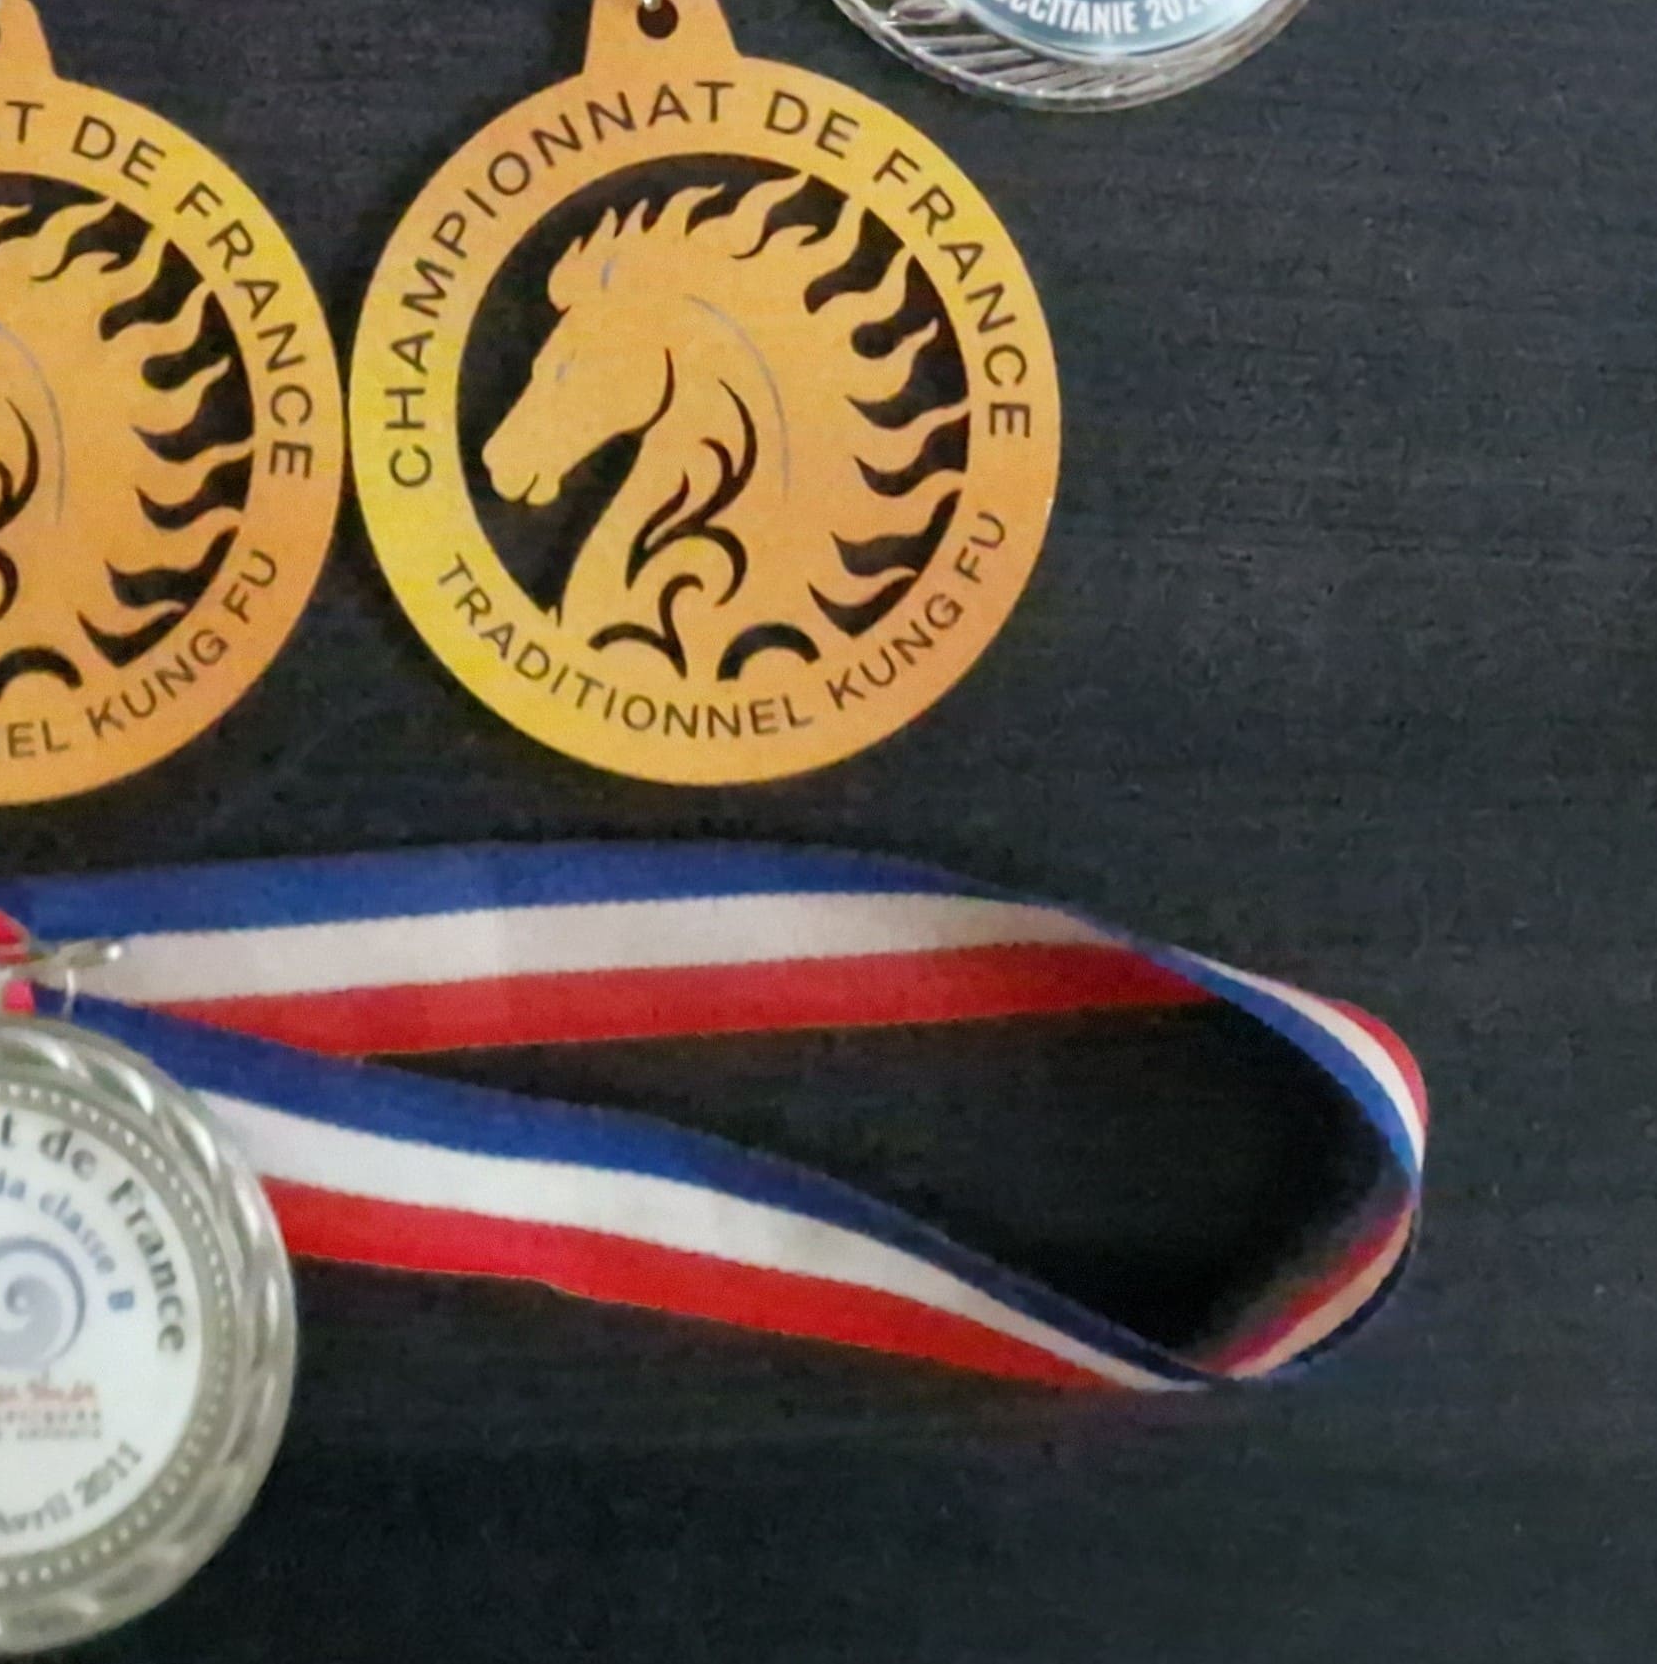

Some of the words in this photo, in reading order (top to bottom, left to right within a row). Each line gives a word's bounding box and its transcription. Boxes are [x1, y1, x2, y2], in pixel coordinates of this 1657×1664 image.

[70, 113, 166, 190] DE
[173, 181, 315, 481] FRANCE
[388, 81, 735, 488] CHAMPIONNAT
[763, 91, 859, 159] DE
[872, 149, 1032, 439] FRANCE
[85, 625, 230, 740] KUNG
[220, 547, 279, 627] FU
[435, 553, 815, 739] TRADITIONNEL
[825, 588, 967, 713] KUNG
[957, 509, 1007, 588] FU
[37, 1189, 117, 1273] classe
[37, 1127, 99, 1182] de
[108, 1177, 187, 1355] France
